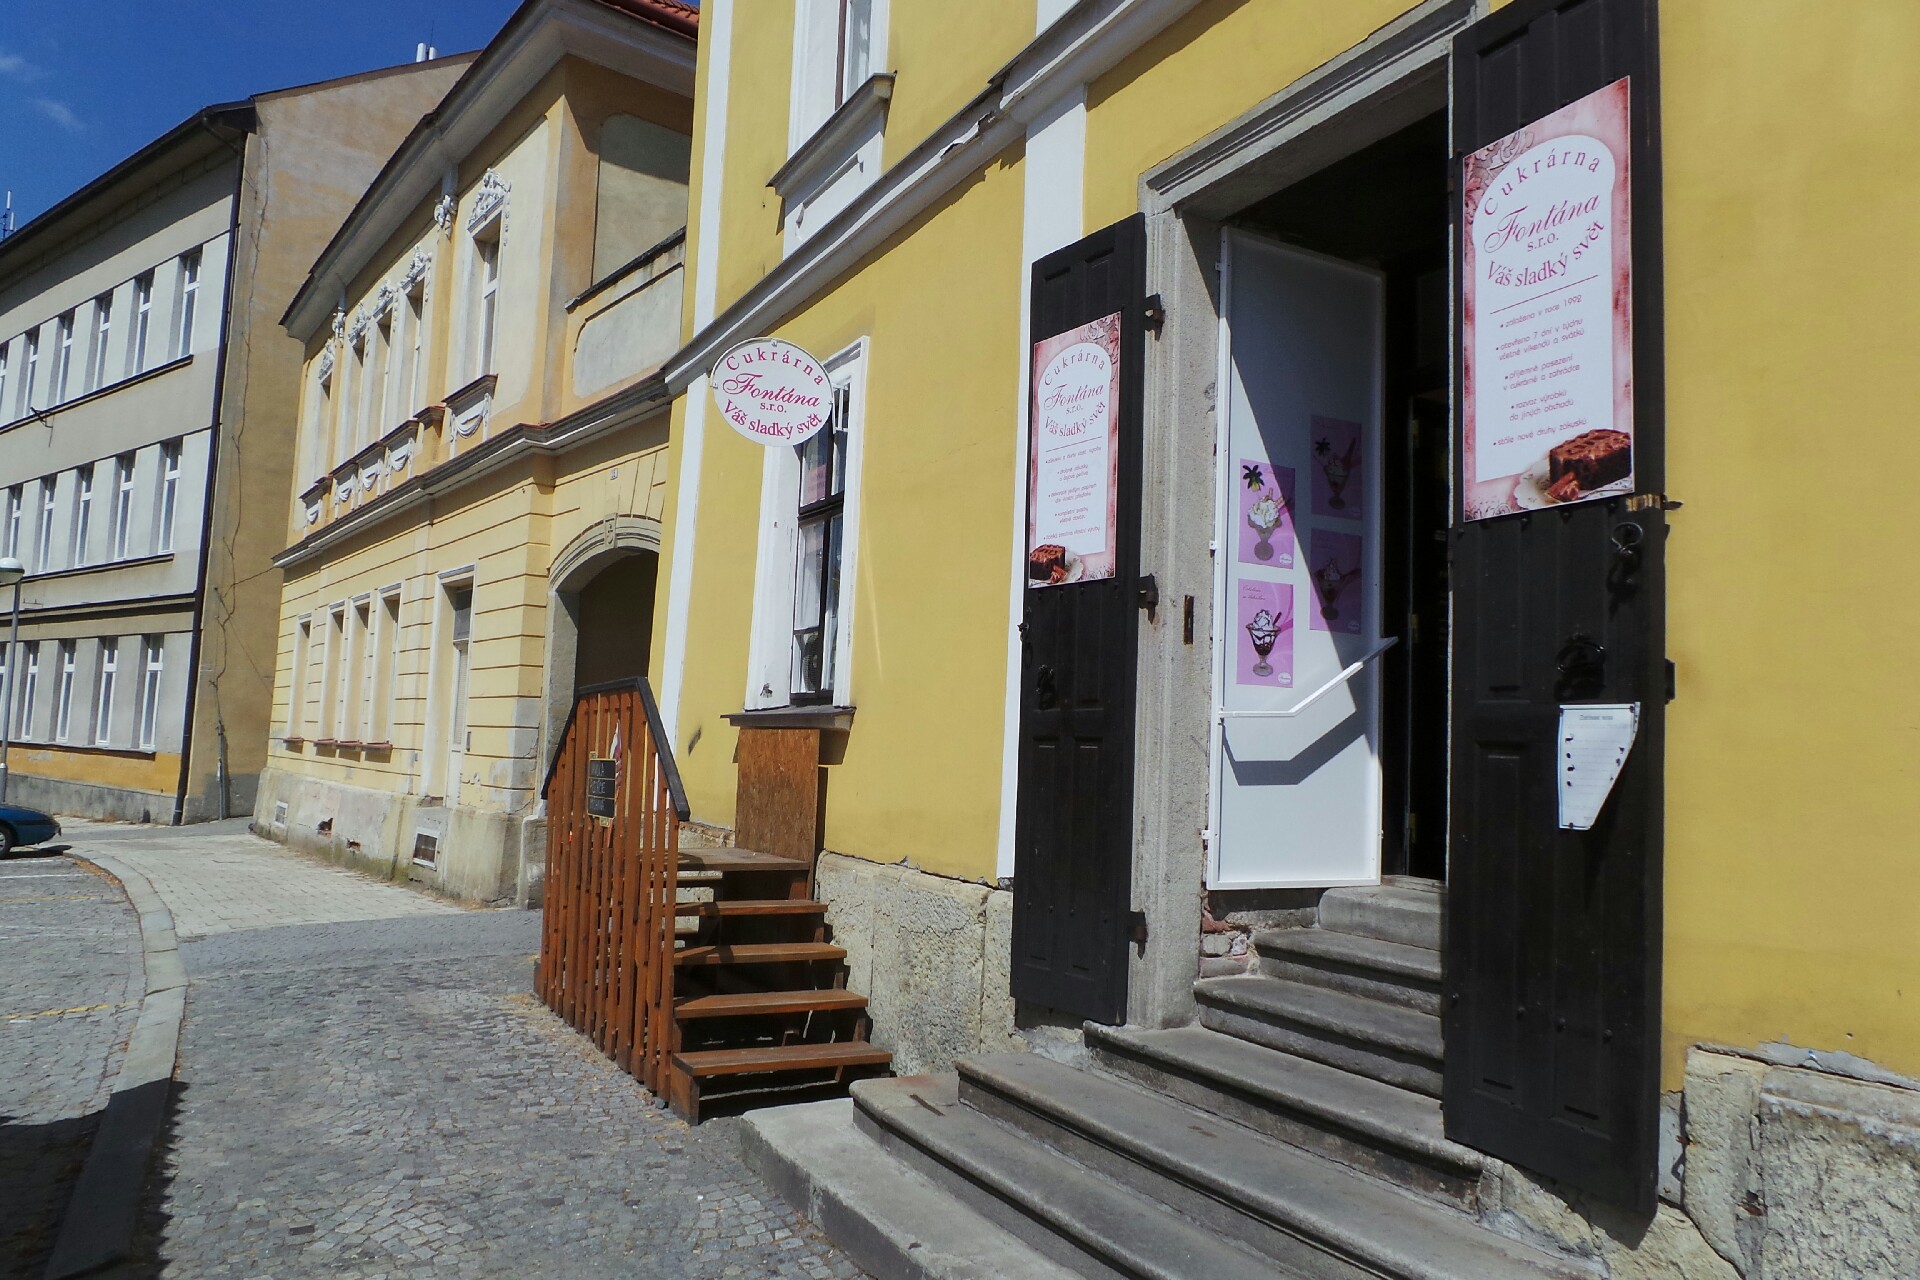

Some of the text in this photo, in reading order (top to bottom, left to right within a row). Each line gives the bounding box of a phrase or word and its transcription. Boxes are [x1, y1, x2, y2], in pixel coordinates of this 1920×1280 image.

[1484, 148, 1600, 216] Cukrárna
[1483, 194, 1600, 253] Fontána
[1527, 232, 1559, 252] s.r.o.
[1487, 220, 1605, 287] Váš sladký svět
[1564, 294, 1582, 307] 1992
[726, 347, 823, 385] Cukrárna
[1044, 348, 1105, 386] Cukrárna
[722, 373, 820, 407] Fontána
[760, 402, 787, 413] s.r.o.
[1043, 383, 1104, 411] Fontána
[724, 399, 823, 440] Váš sladký svět
[1045, 401, 1106, 437] Váš sladký svět
